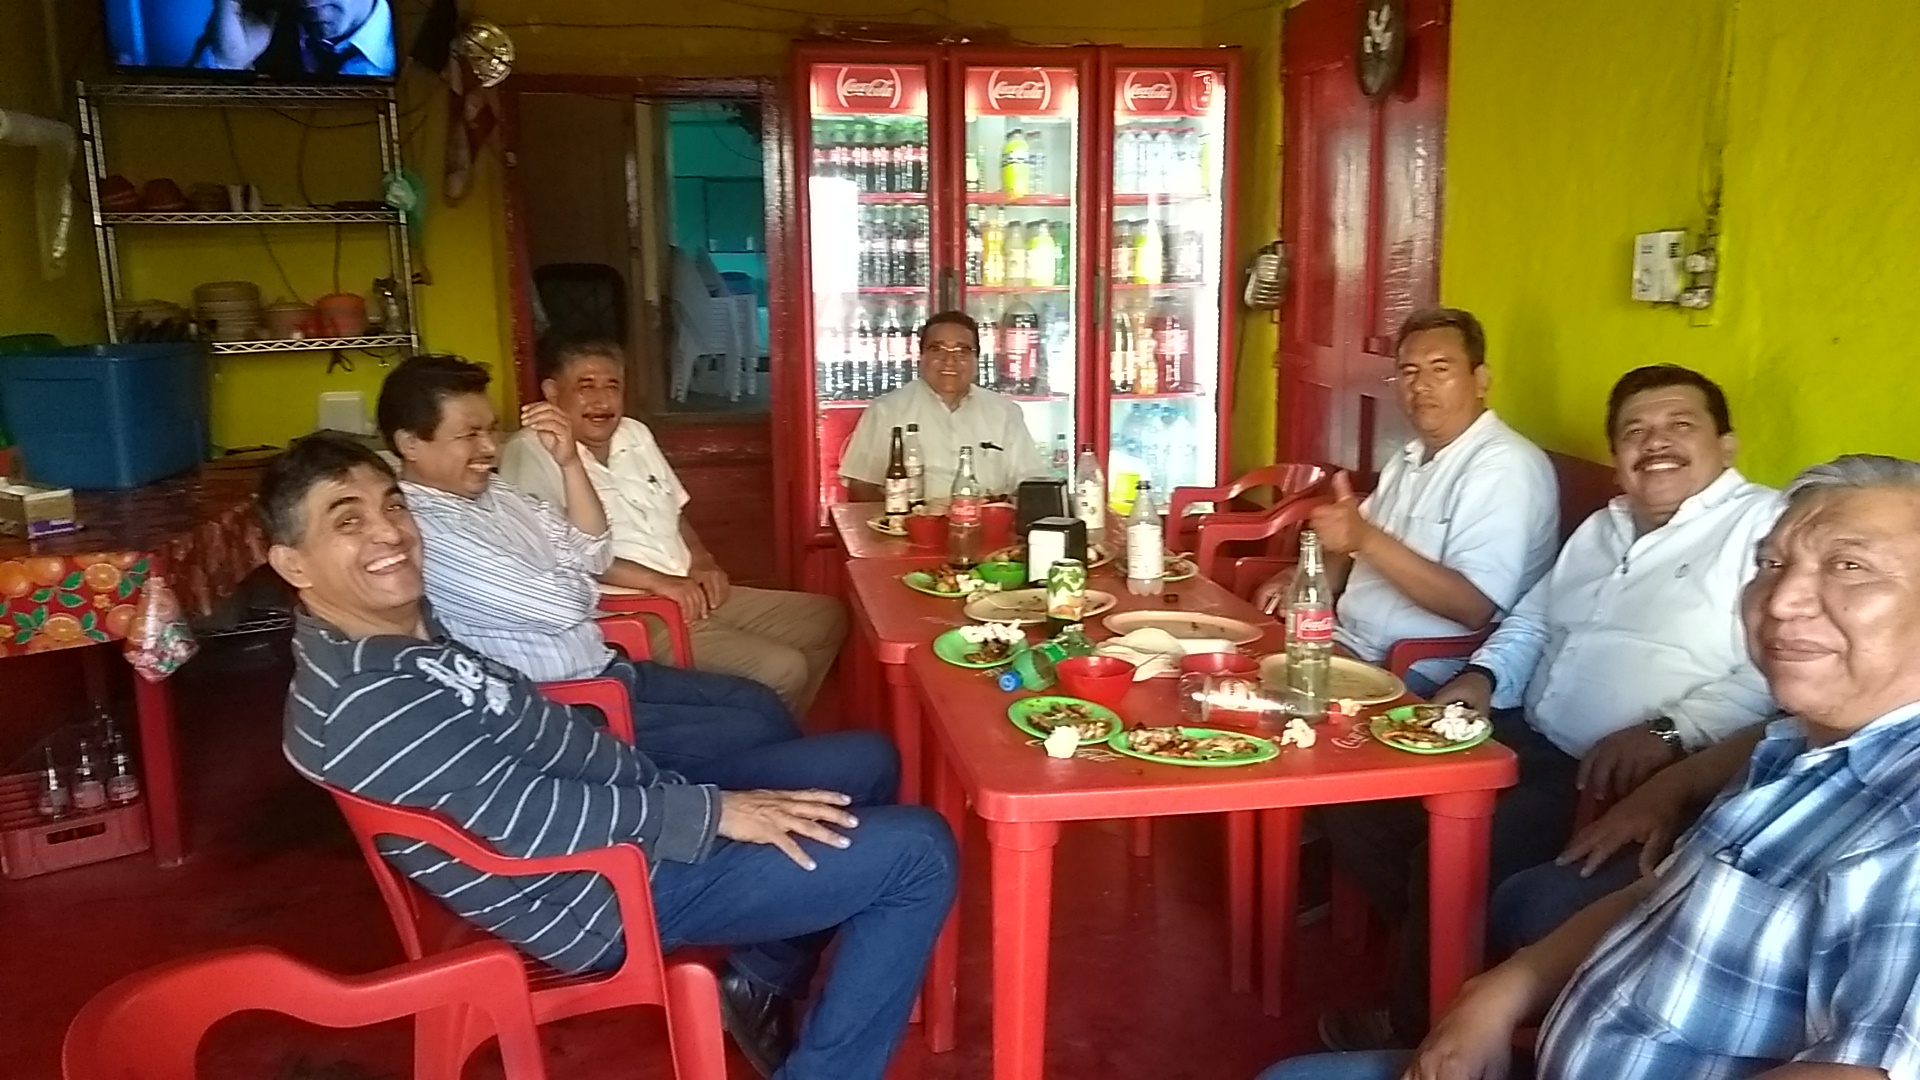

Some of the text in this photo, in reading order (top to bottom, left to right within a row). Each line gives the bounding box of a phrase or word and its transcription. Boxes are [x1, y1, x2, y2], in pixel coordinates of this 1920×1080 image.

[842, 78, 894, 97] Coca-Cola
[993, 81, 1044, 99] Coca-Cola
[1129, 83, 1171, 99] Coca-Cola
